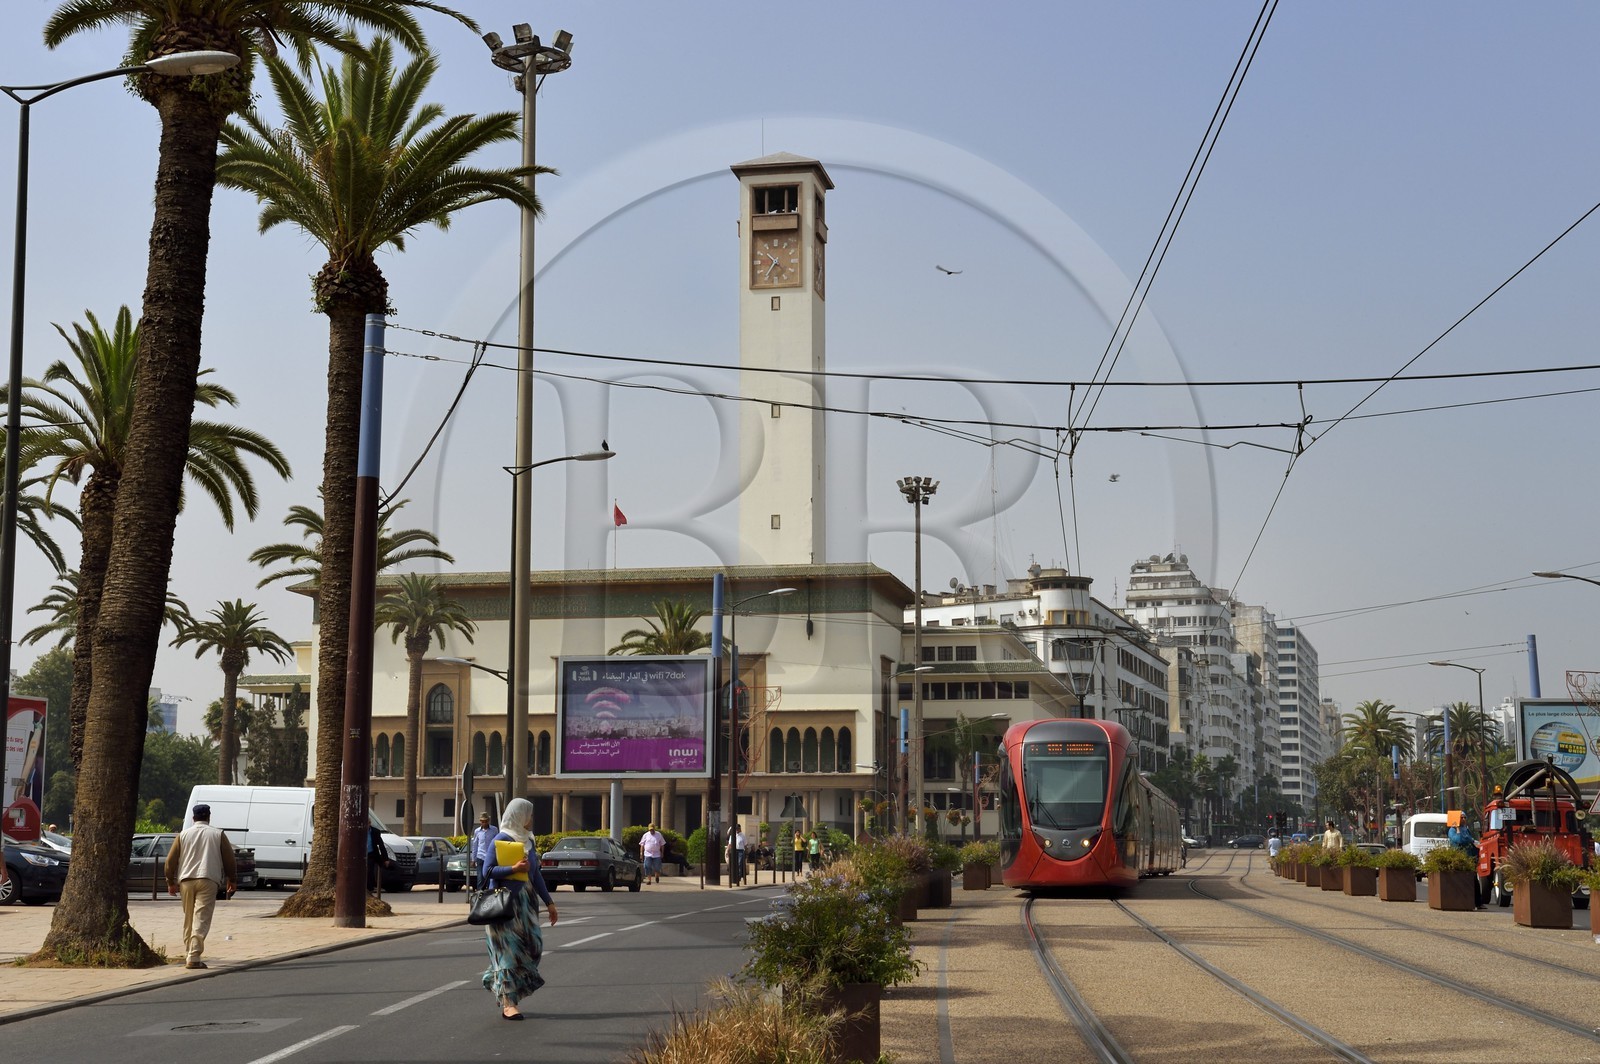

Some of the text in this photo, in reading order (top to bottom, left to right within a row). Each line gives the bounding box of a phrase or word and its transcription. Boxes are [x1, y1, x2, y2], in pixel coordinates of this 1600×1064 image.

[602, 671, 625, 682] البيضاء
[626, 671, 641, 682] الدار
[641, 672, 648, 684] في
[649, 671, 664, 679] wifi
